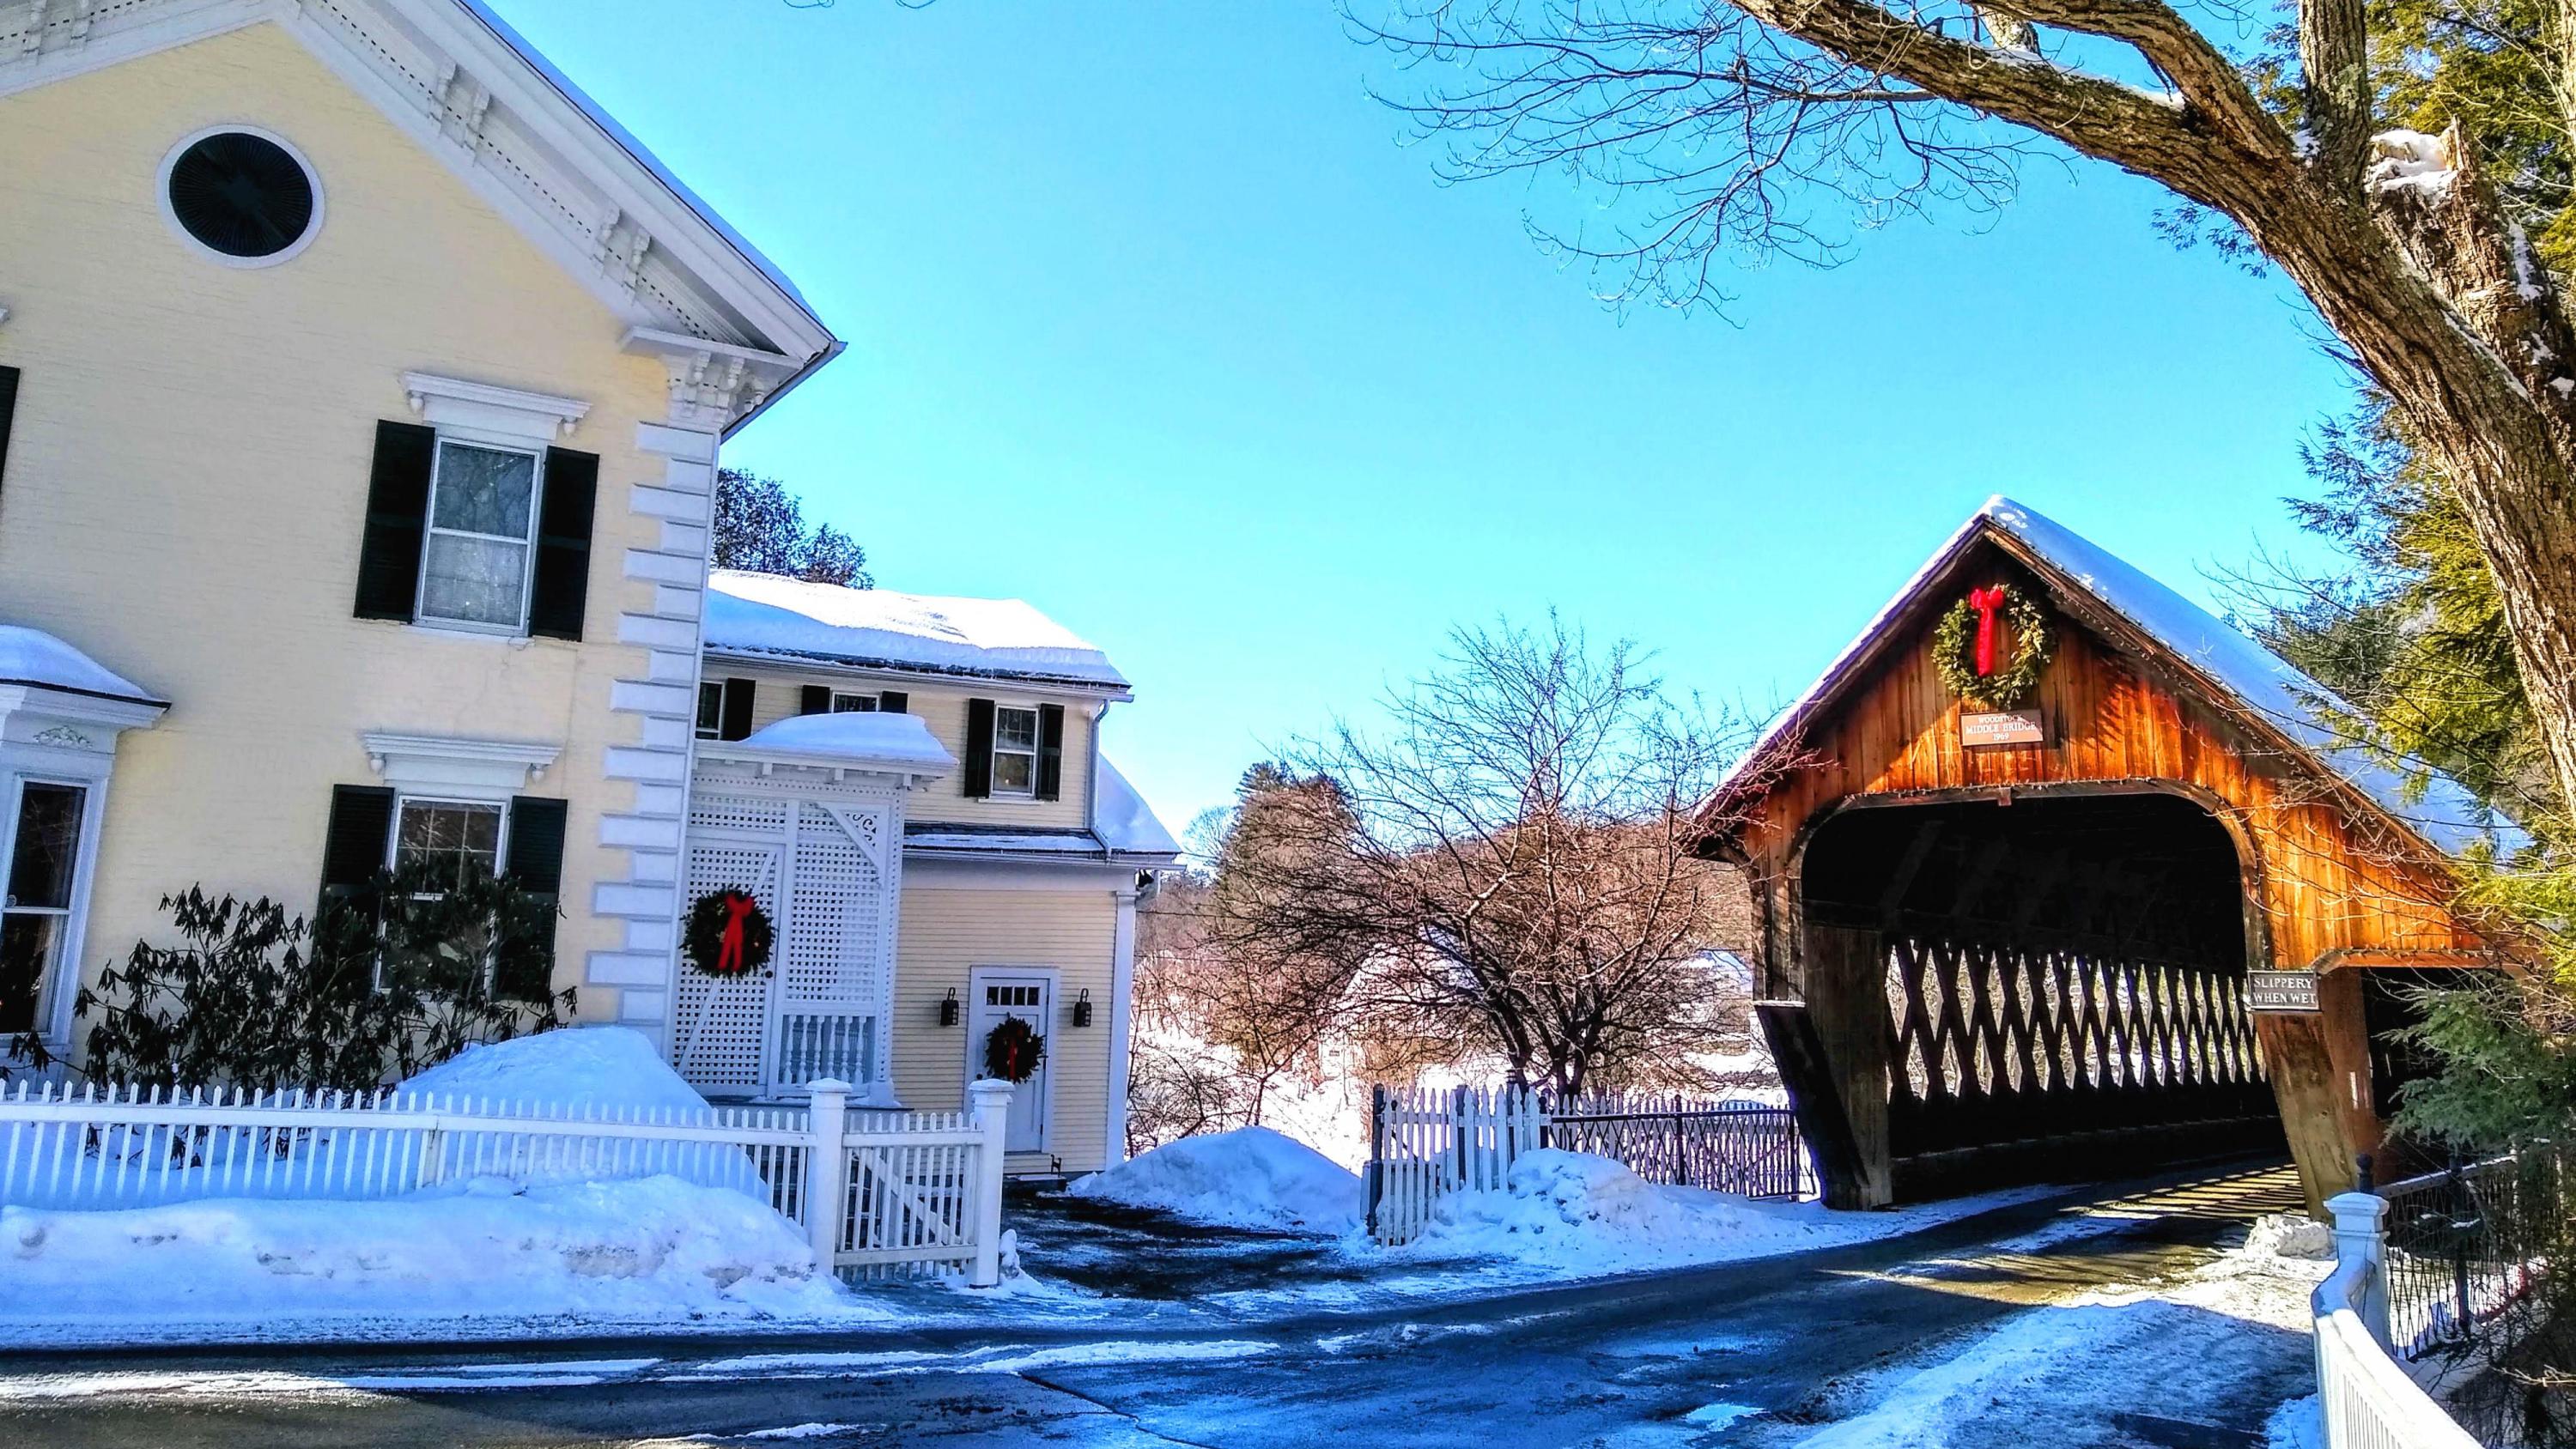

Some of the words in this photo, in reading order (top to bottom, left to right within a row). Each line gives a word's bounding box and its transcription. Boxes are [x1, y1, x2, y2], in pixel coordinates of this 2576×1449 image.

[1978, 713, 2022, 724] WOODSTOCK
[1965, 724, 2000, 734] MIDDLE
[2002, 722, 2036, 731] BRIDGE
[2254, 978, 2313, 989] SLIPPERY
[2253, 992, 2287, 1003] WHEN
[2290, 992, 2316, 1003] WET
